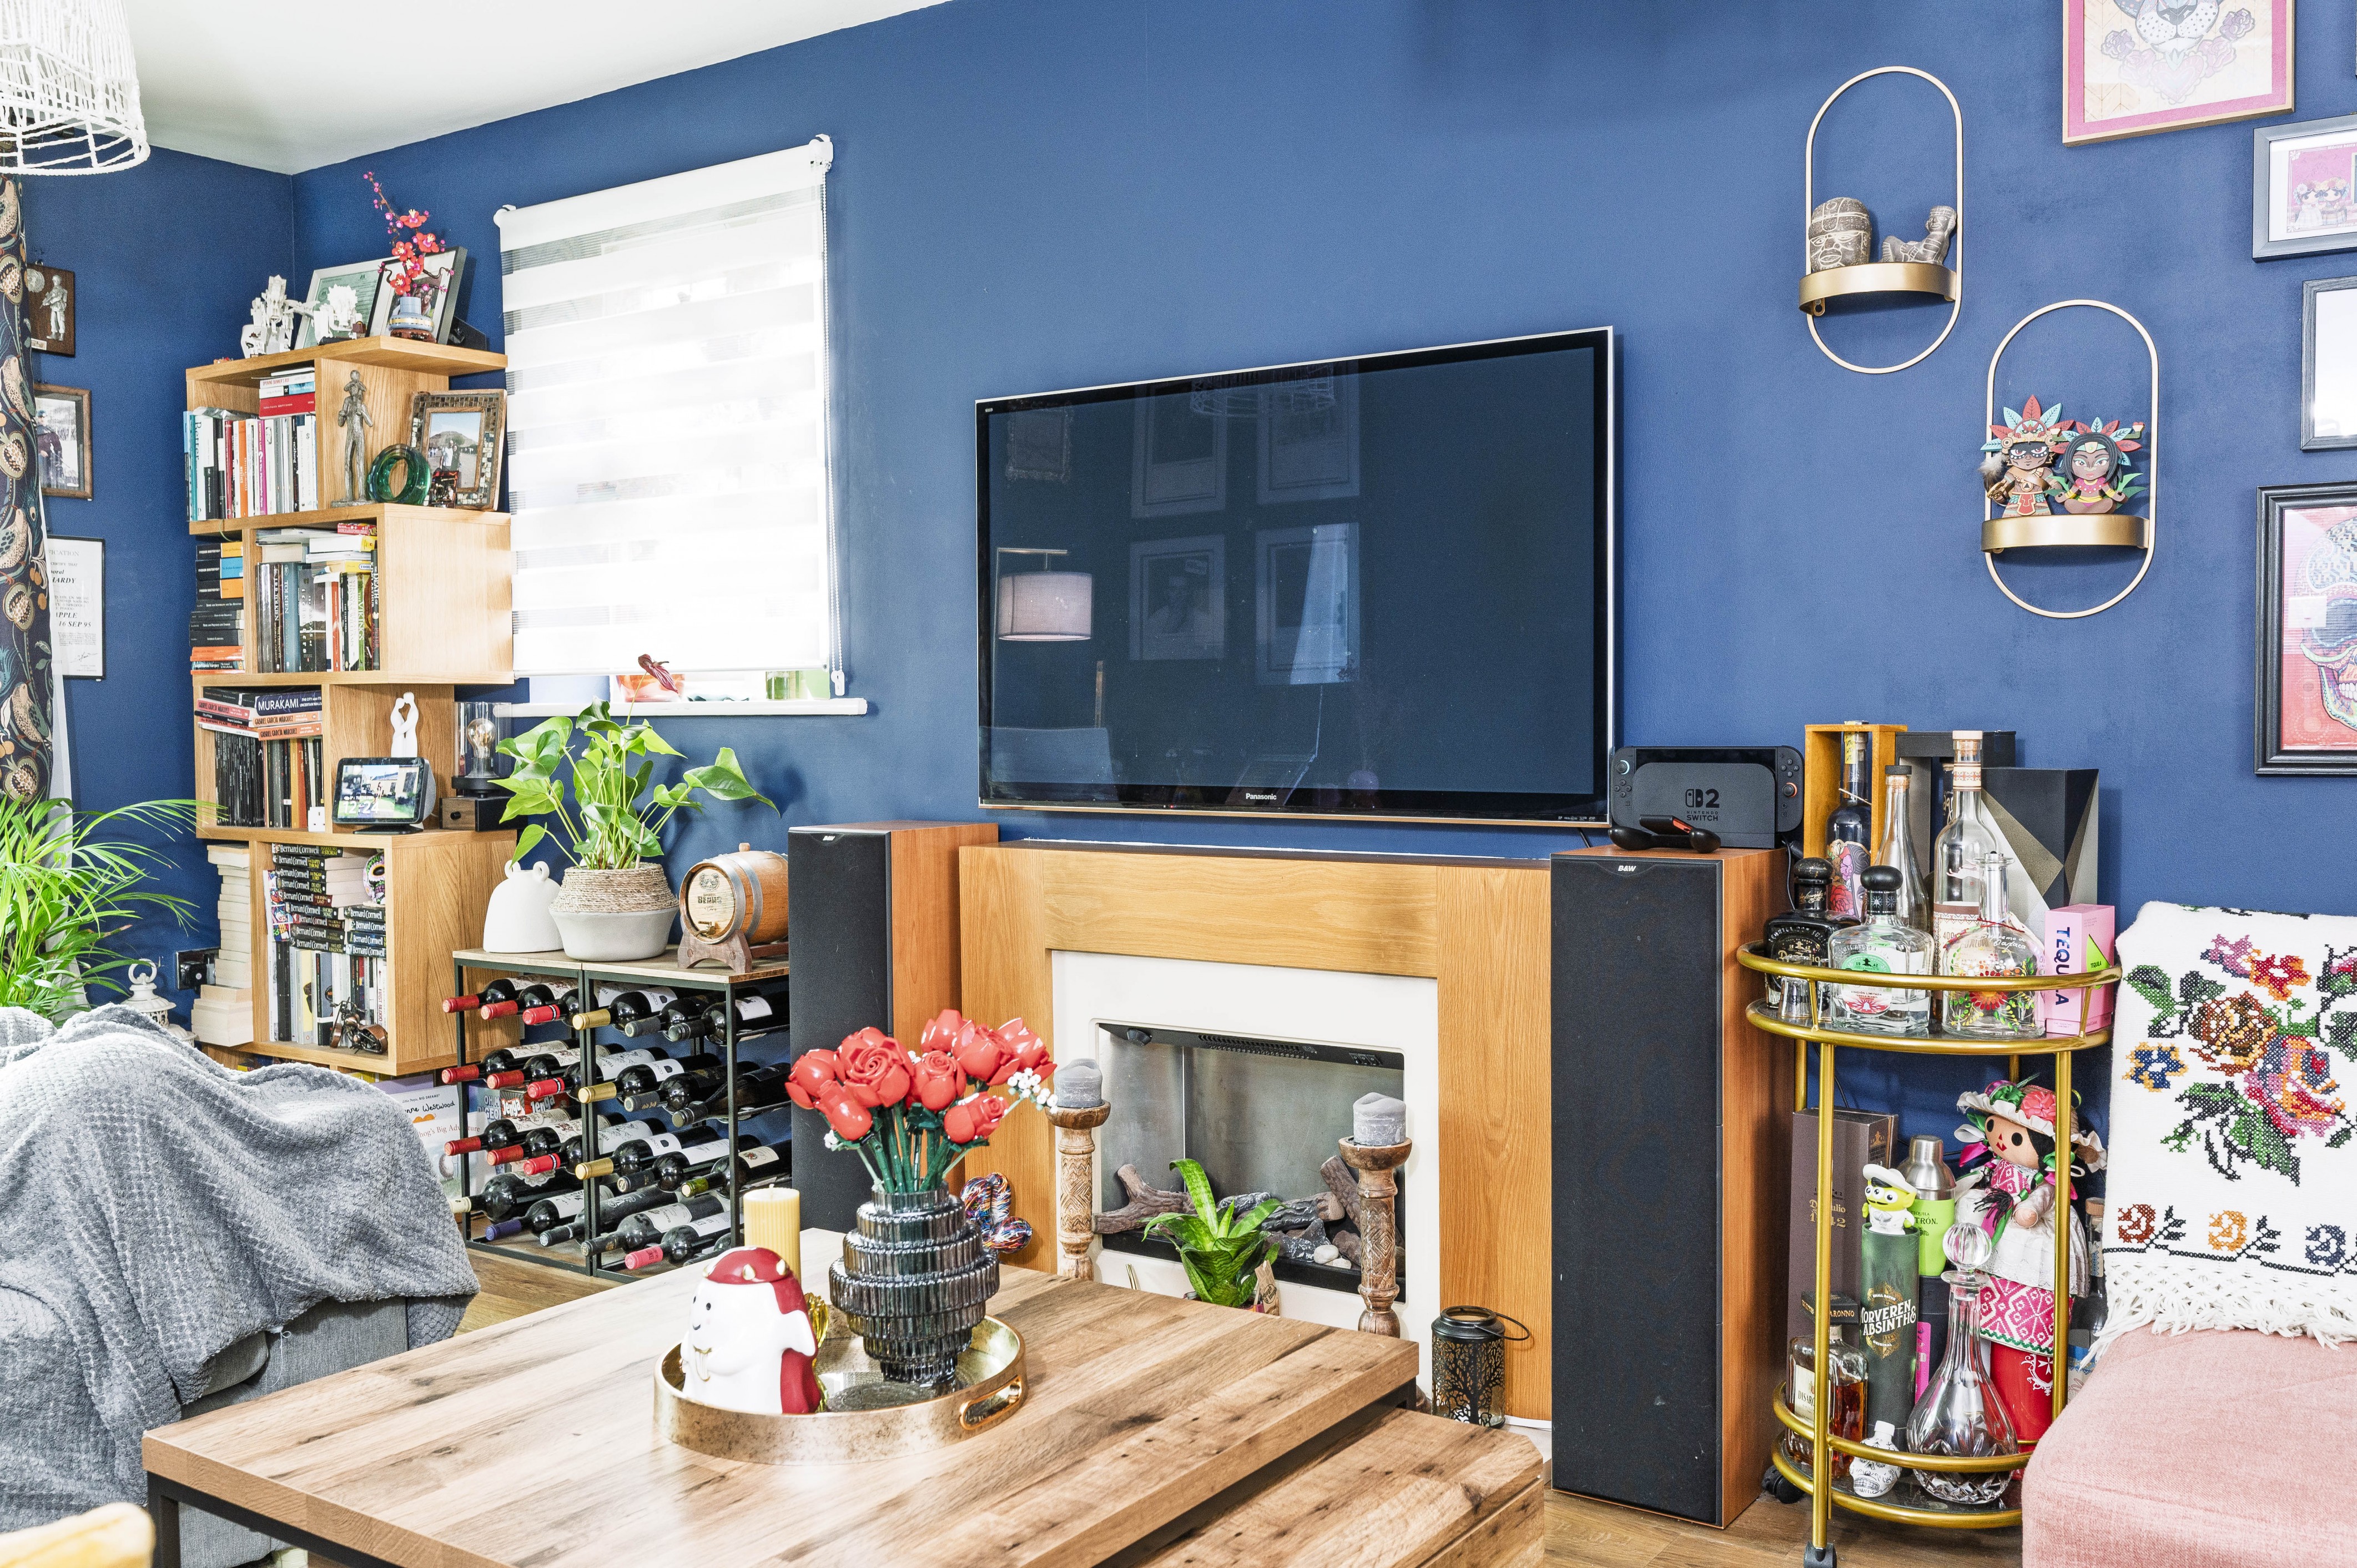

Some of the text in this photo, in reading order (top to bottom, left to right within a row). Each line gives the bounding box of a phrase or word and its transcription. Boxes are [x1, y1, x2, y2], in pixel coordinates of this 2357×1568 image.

[258, 698, 299, 711] MURAKAMI
[1705, 788, 1720, 808] 2
[344, 800, 379, 814] 12:24
[280, 844, 319, 854] Bernard Cornwell
[279, 856, 308, 866] Bernard Cornwell
[281, 869, 309, 878] Bernard Cornwell
[281, 880, 310, 890] Bernard Cornwell
[283, 892, 314, 902] Bernard Cornwell
[290, 904, 320, 915] Bernard Cornwell
[350, 909, 382, 919] Bernard Cornwell
[299, 915, 328, 926] Bernard Cornwell
[356, 921, 370, 930] Bernard
[311, 929, 326, 938] Cornwell
[353, 934, 383, 945] Bernard Cornwell
[311, 942, 329, 950] Cornwell
[352, 945, 385, 957] Bernard Cornwell
[2054, 927, 2070, 1005] TEQUA
[422, 1100, 455, 1112] Westwood
[484, 1095, 493, 1107] OH
[531, 1095, 555, 1114] Jenga
[502, 1099, 521, 1117] Jenga
[449, 1124, 480, 1132] Advture
